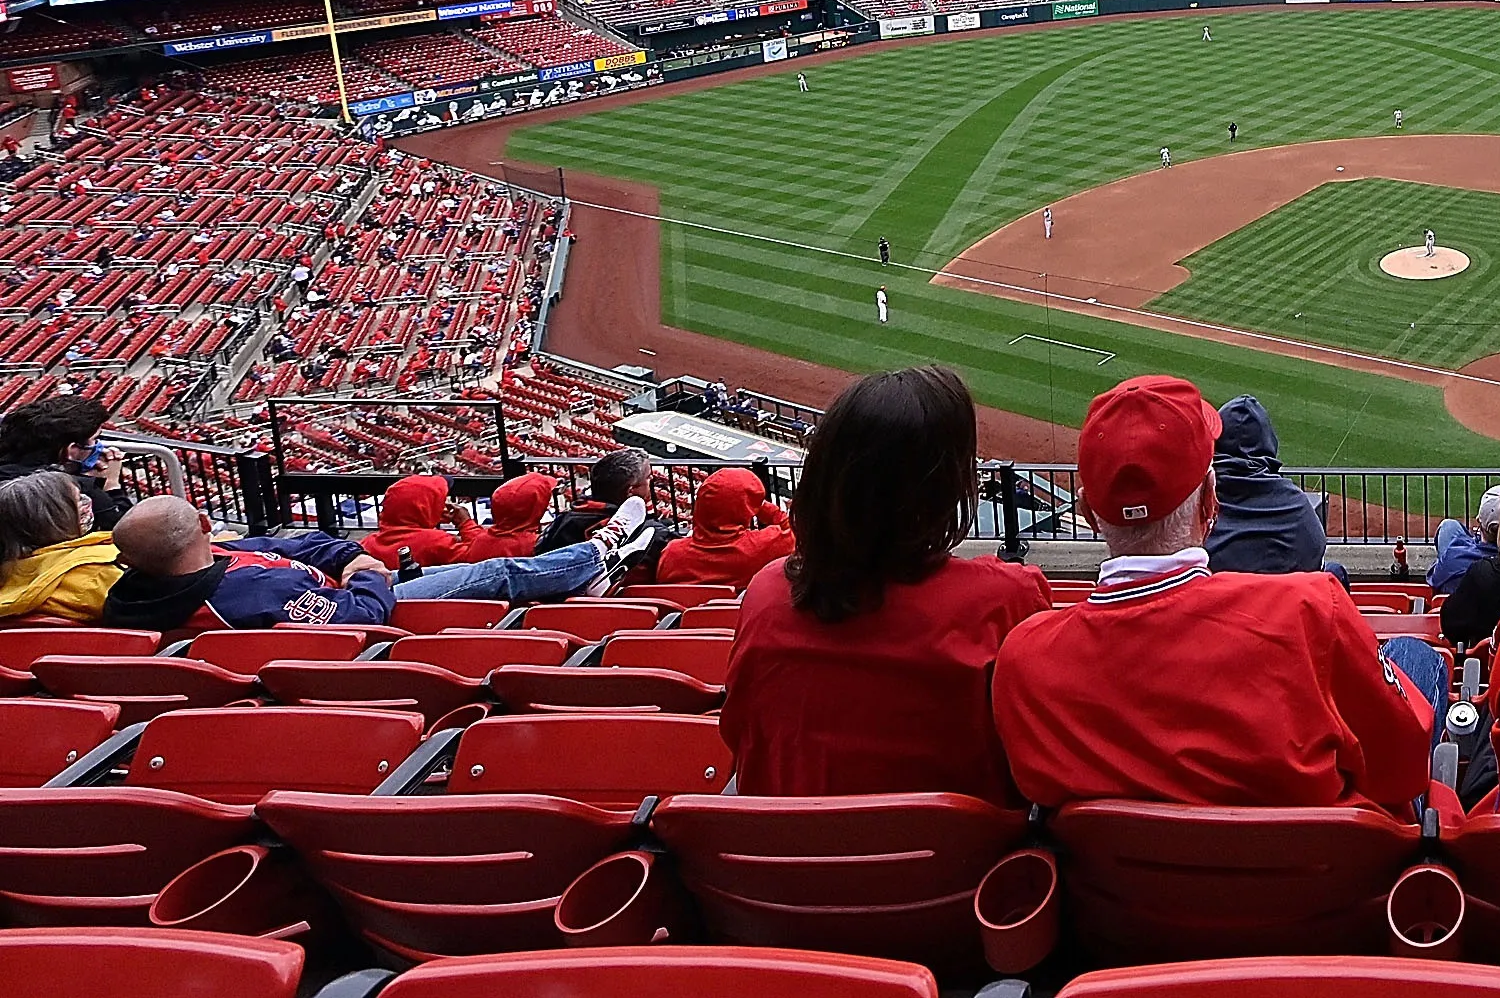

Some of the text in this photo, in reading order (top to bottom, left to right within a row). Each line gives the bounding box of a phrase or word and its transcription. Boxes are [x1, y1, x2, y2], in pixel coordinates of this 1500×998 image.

[438, 6, 478, 17] WINDOW
[479, 2, 511, 12] NATION
[775, 2, 799, 11] PURINA
[1064, 2, 1096, 13] National
[281, 12, 430, 38] FLEXIBILITY CONVENIENCE EXPERIENCE
[172, 33, 267, 53] Webster University
[605, 54, 636, 65] DOBBS
[553, 62, 592, 74] SITEMAN
[491, 73, 538, 88] Central Bank
